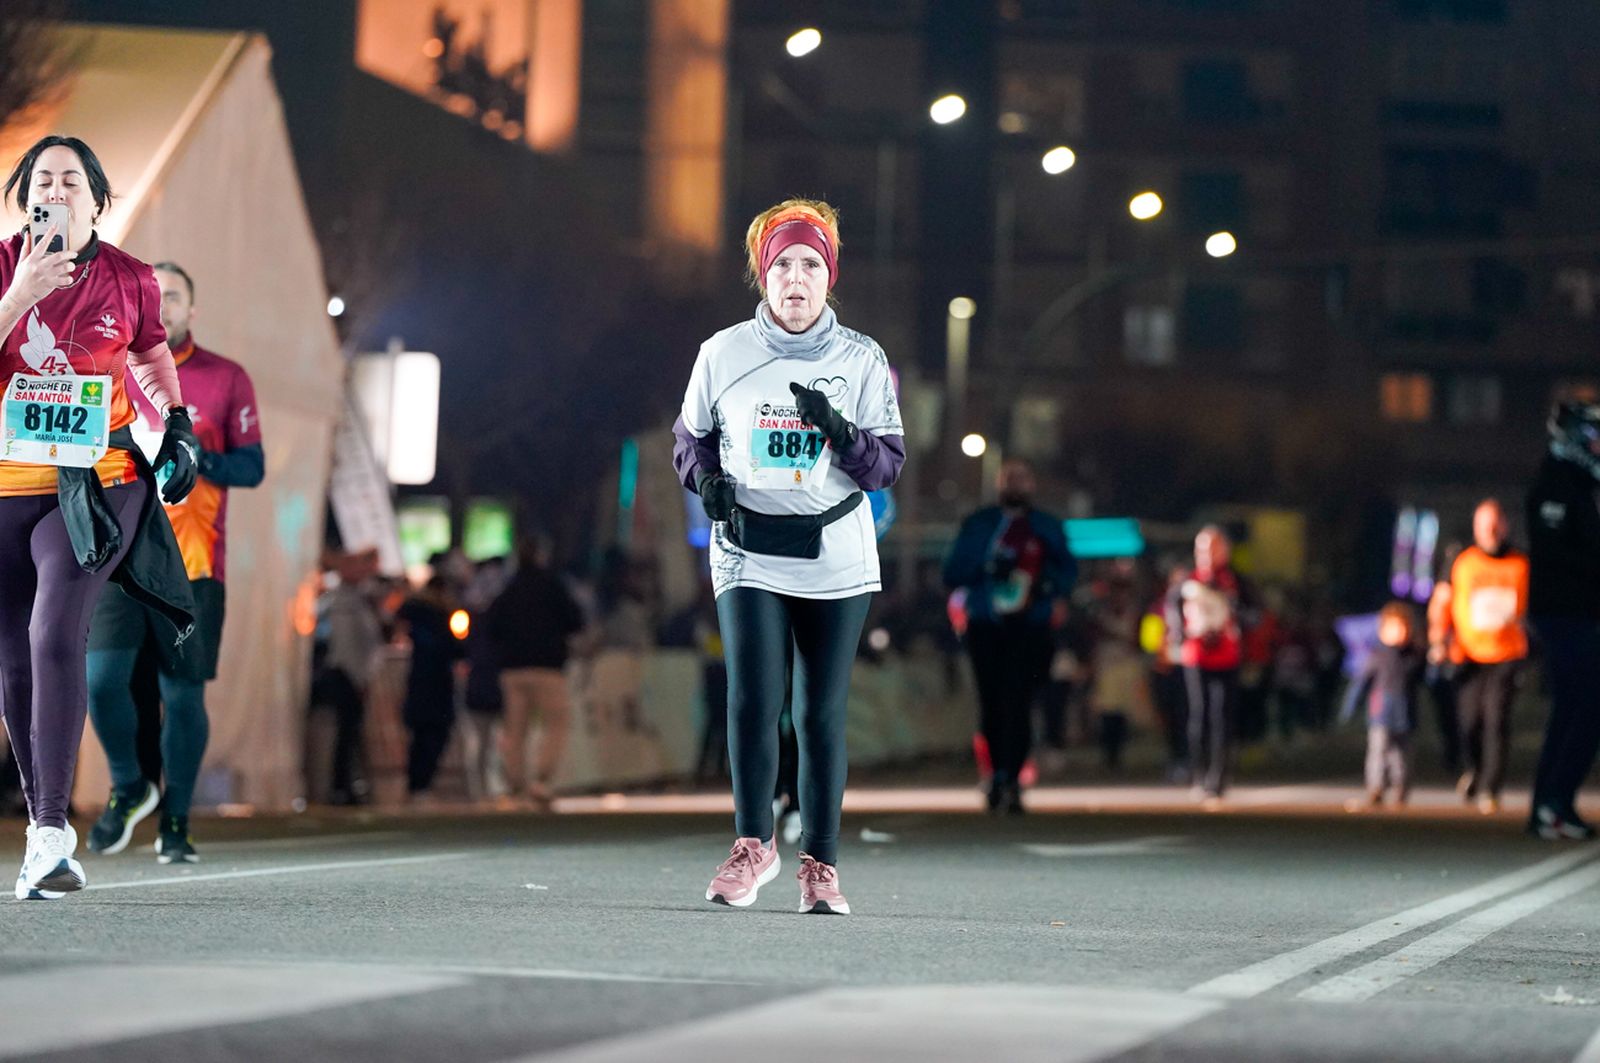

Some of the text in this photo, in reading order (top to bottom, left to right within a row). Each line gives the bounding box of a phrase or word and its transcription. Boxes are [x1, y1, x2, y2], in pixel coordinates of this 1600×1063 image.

[28, 382, 57, 391] NOCHE
[60, 383, 73, 392] DE
[15, 391, 36, 401] SAN
[37, 392, 72, 404] ANTÓN
[24, 403, 88, 435] 8142
[759, 418, 779, 429] SAN
[35, 433, 56, 442] MARÍA
